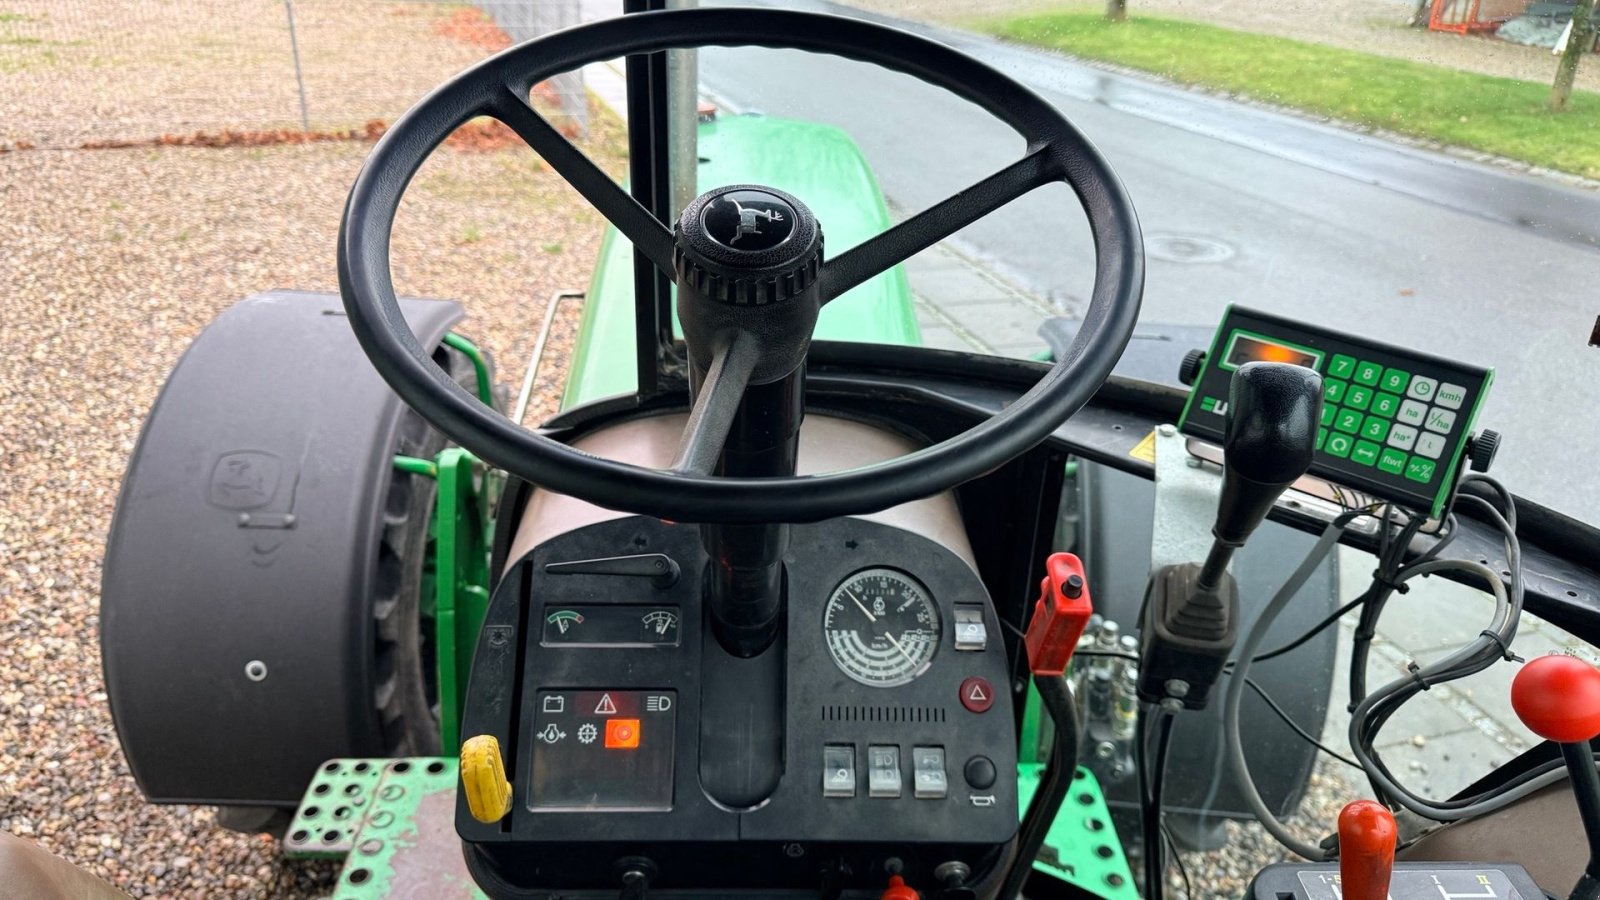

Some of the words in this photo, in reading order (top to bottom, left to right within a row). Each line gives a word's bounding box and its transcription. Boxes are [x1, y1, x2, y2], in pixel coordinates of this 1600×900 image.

[1338, 361, 1348, 372] 7
[1362, 368, 1373, 379] 8
[1389, 375, 1400, 387] 9
[1327, 385, 1338, 396] 4
[1352, 392, 1363, 403] 5
[1379, 399, 1390, 411] 6
[1439, 389, 1462, 403] kmh
[1405, 407, 1419, 419] ha
[1342, 415, 1354, 427] 2
[1369, 423, 1381, 435] 3
